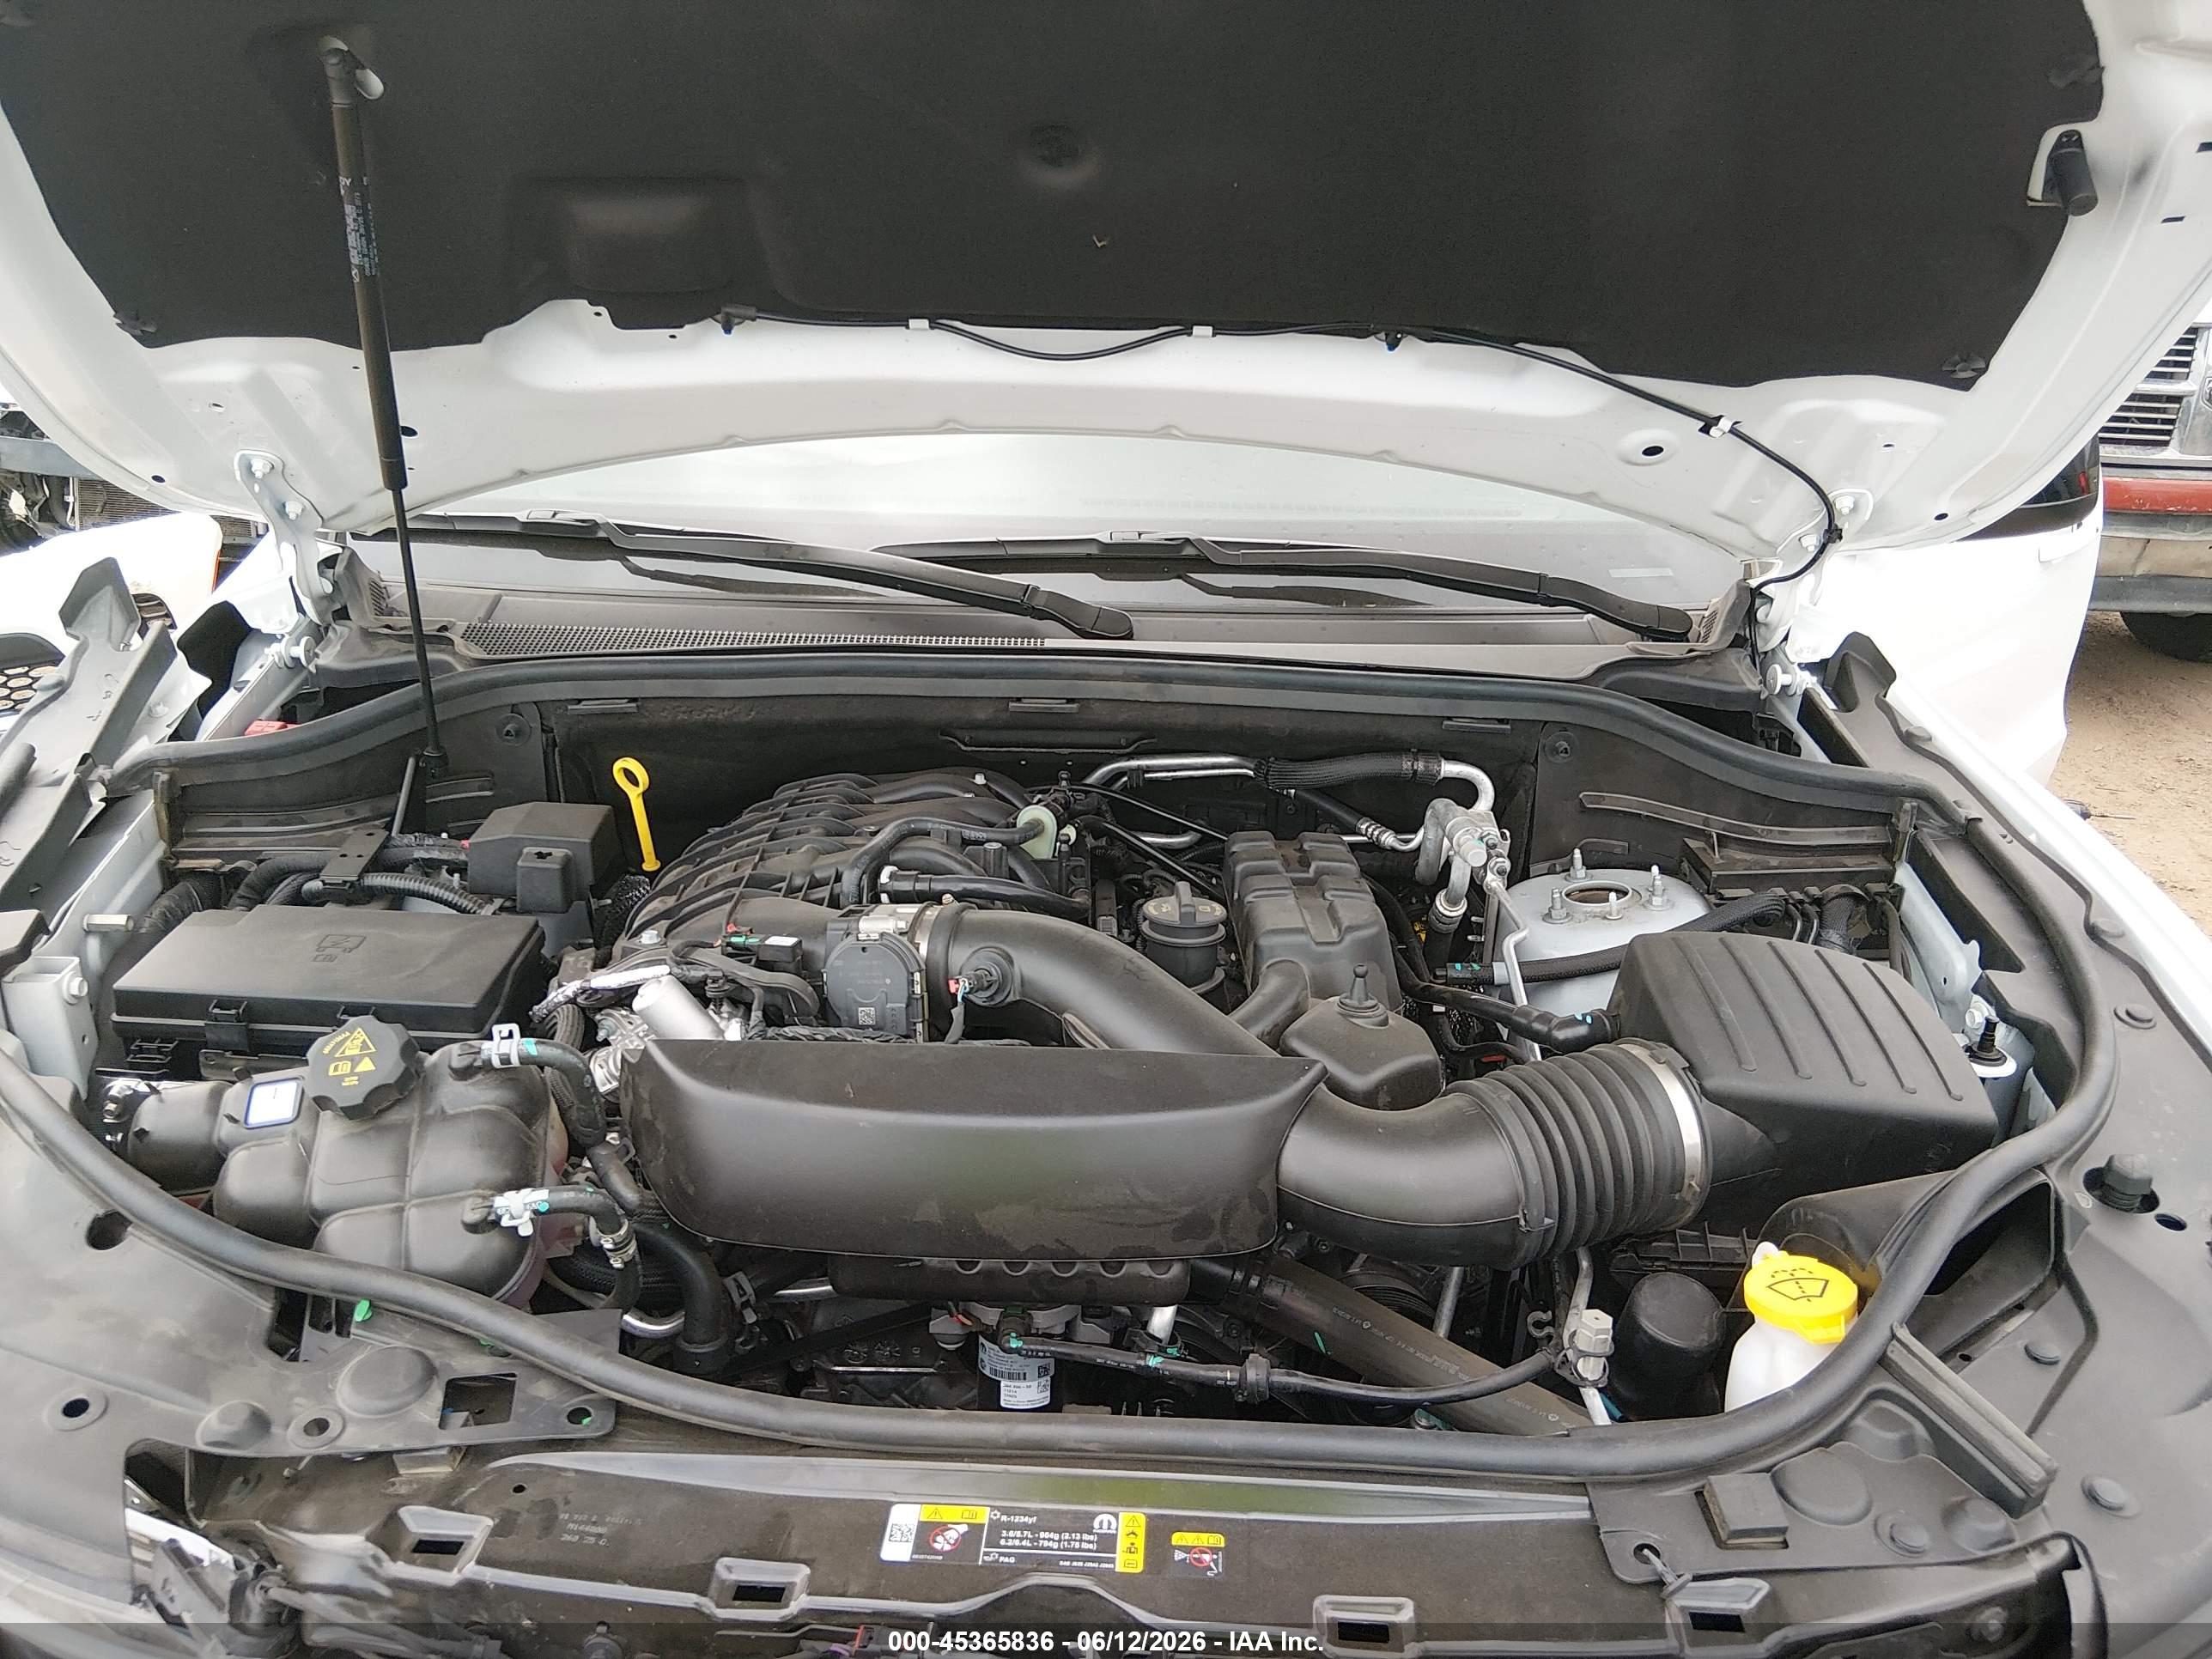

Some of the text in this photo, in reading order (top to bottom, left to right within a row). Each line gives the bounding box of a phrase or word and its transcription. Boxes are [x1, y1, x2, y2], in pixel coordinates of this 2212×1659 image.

[1000, 1514, 1037, 1524] R-1234yf
[1061, 1532, 1080, 1541] (2.13
[1082, 1533, 1097, 1542] lbs)
[1081, 1542, 1097, 1551] lbs)
